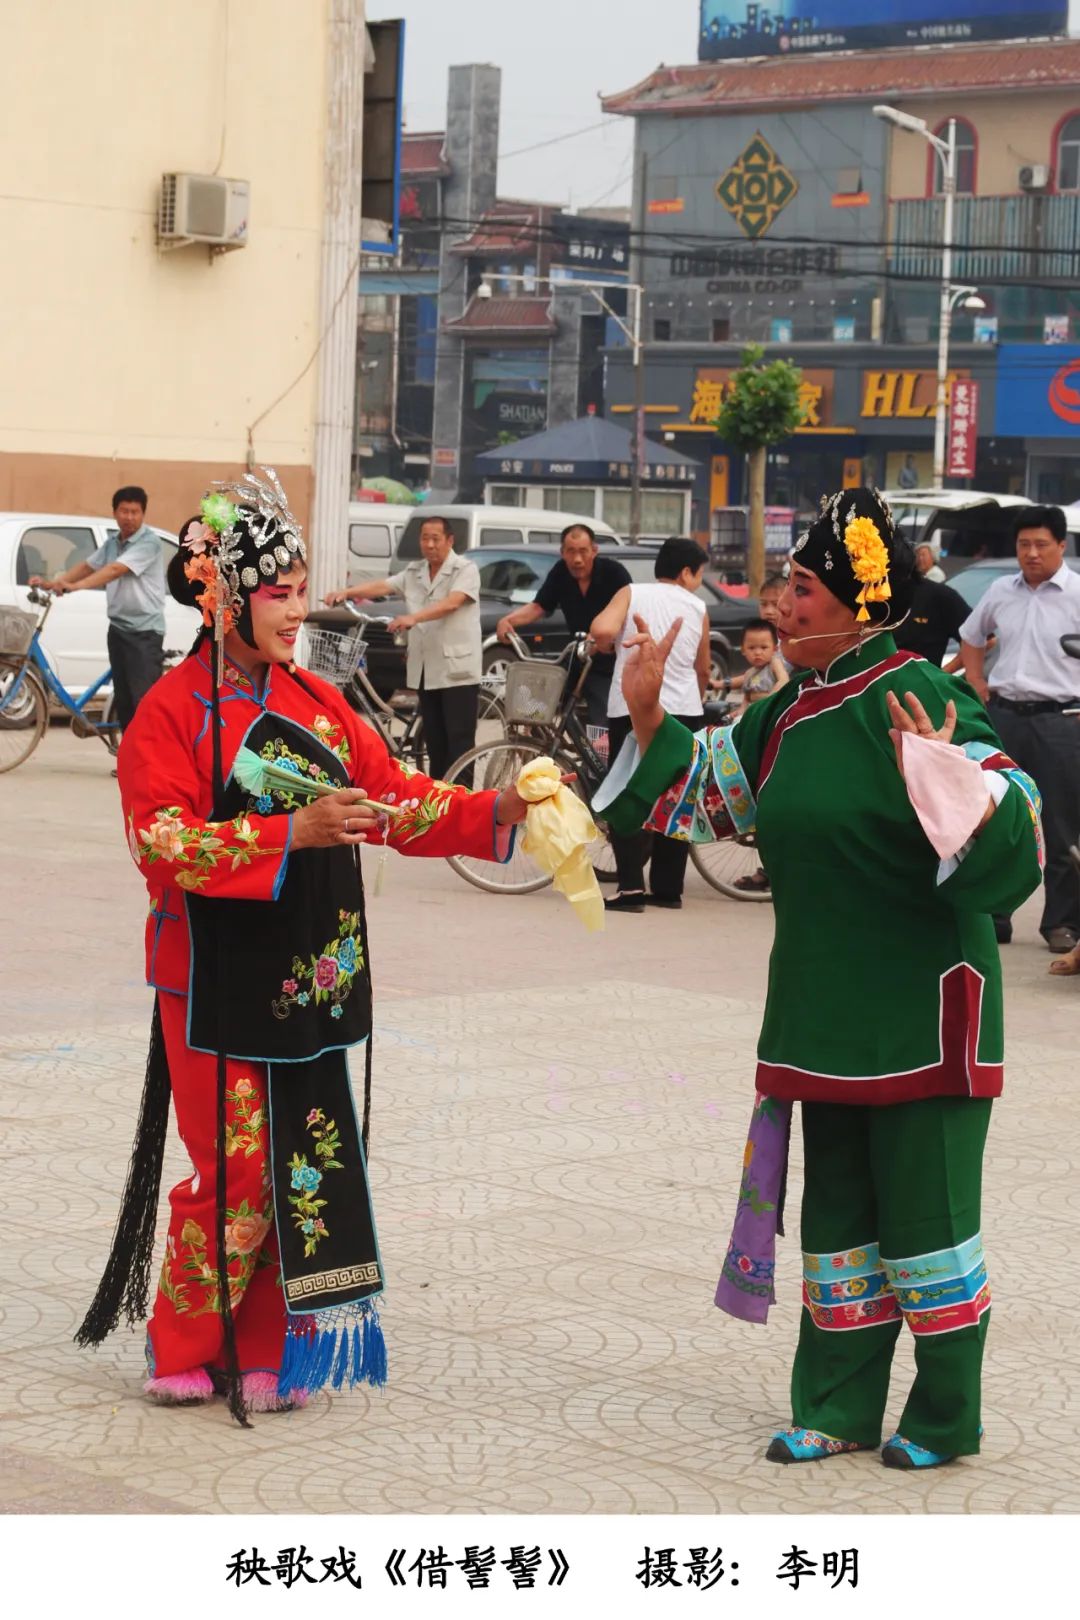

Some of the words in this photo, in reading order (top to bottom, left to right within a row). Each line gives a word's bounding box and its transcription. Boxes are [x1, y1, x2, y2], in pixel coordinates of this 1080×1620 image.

[689, 380, 823, 426] 海家
[500, 460, 523, 474] 公安
[549, 463, 574, 473] POLICE
